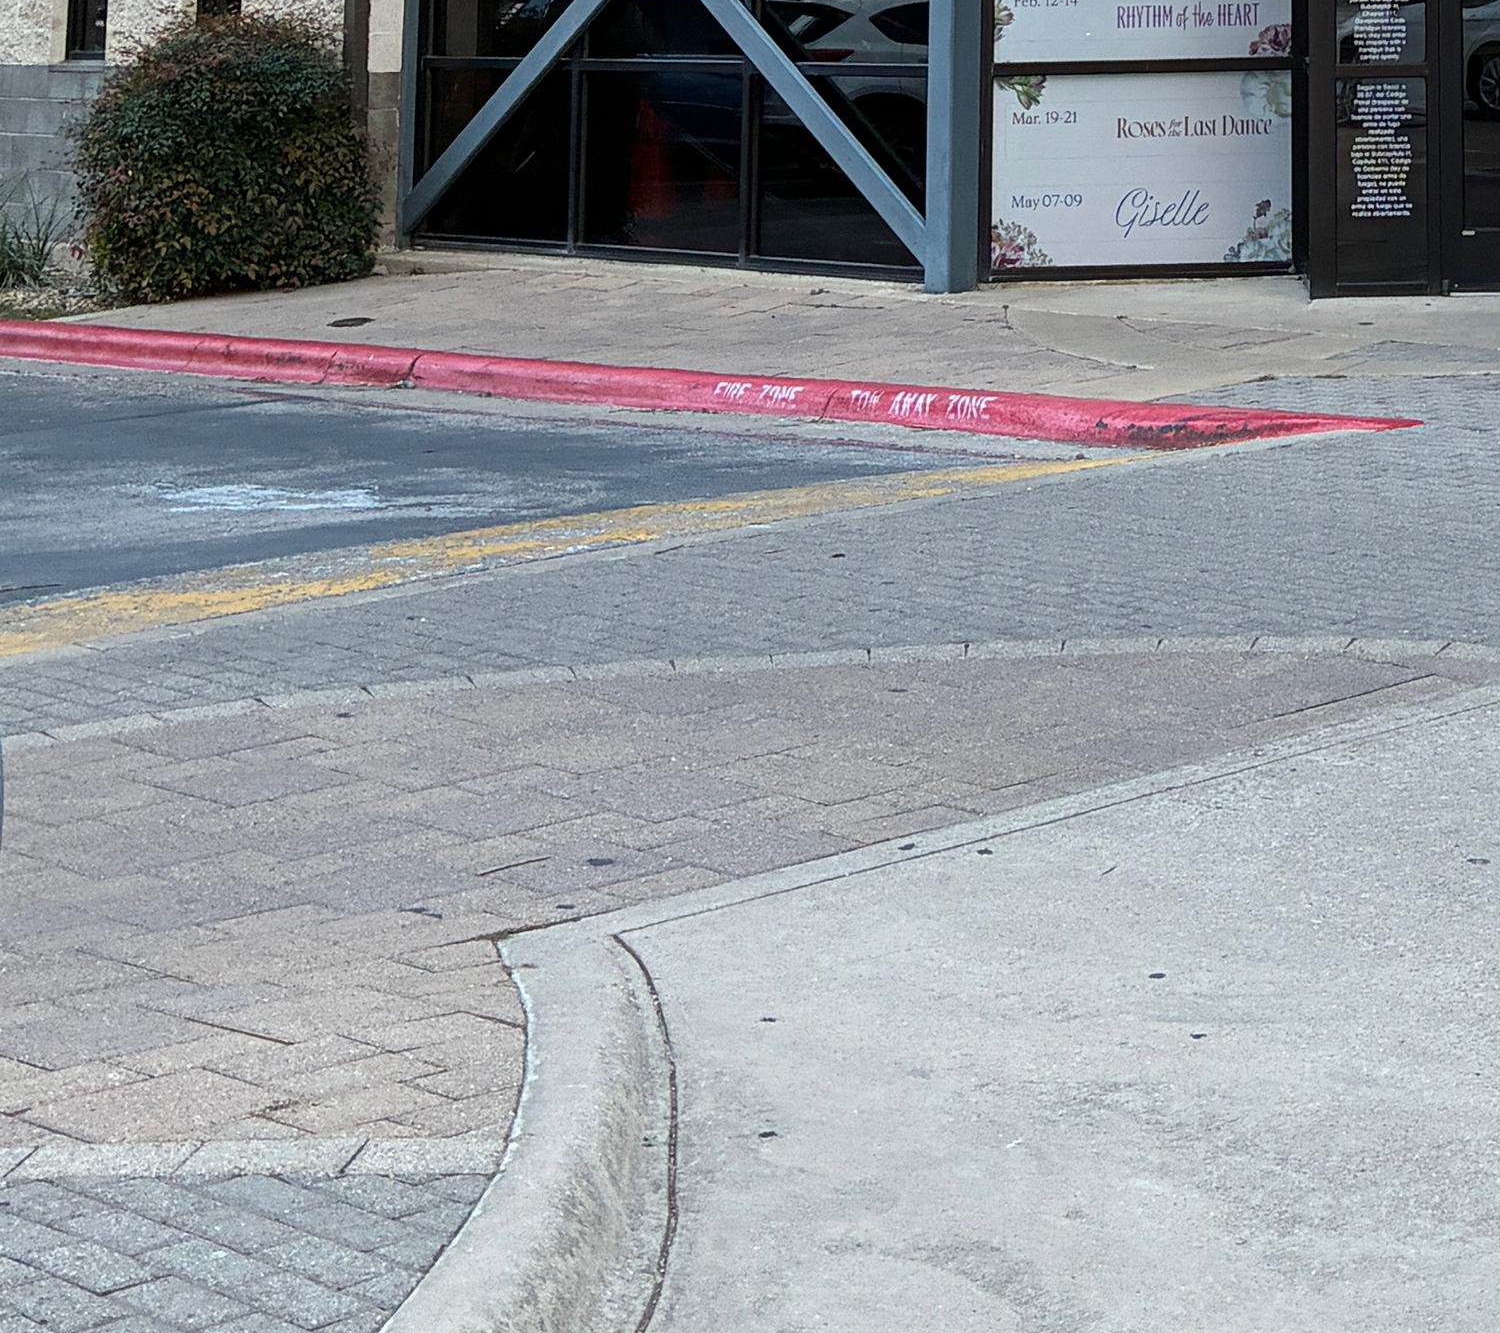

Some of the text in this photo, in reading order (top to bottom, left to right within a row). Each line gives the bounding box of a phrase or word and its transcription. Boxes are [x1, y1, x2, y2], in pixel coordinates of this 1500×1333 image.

[1117, 1, 1260, 30] RHYTHM of the HEART
[1012, 111, 1077, 125] Mar. 19-21
[1117, 117, 1166, 138] Roses
[1184, 116, 1216, 137] Last
[1222, 115, 1272, 137] Dance
[1012, 194, 1083, 209] May 07-09
[1115, 187, 1210, 239] Giselle
[888, 391, 938, 417] AWAY
[946, 395, 998, 420] ZONE
